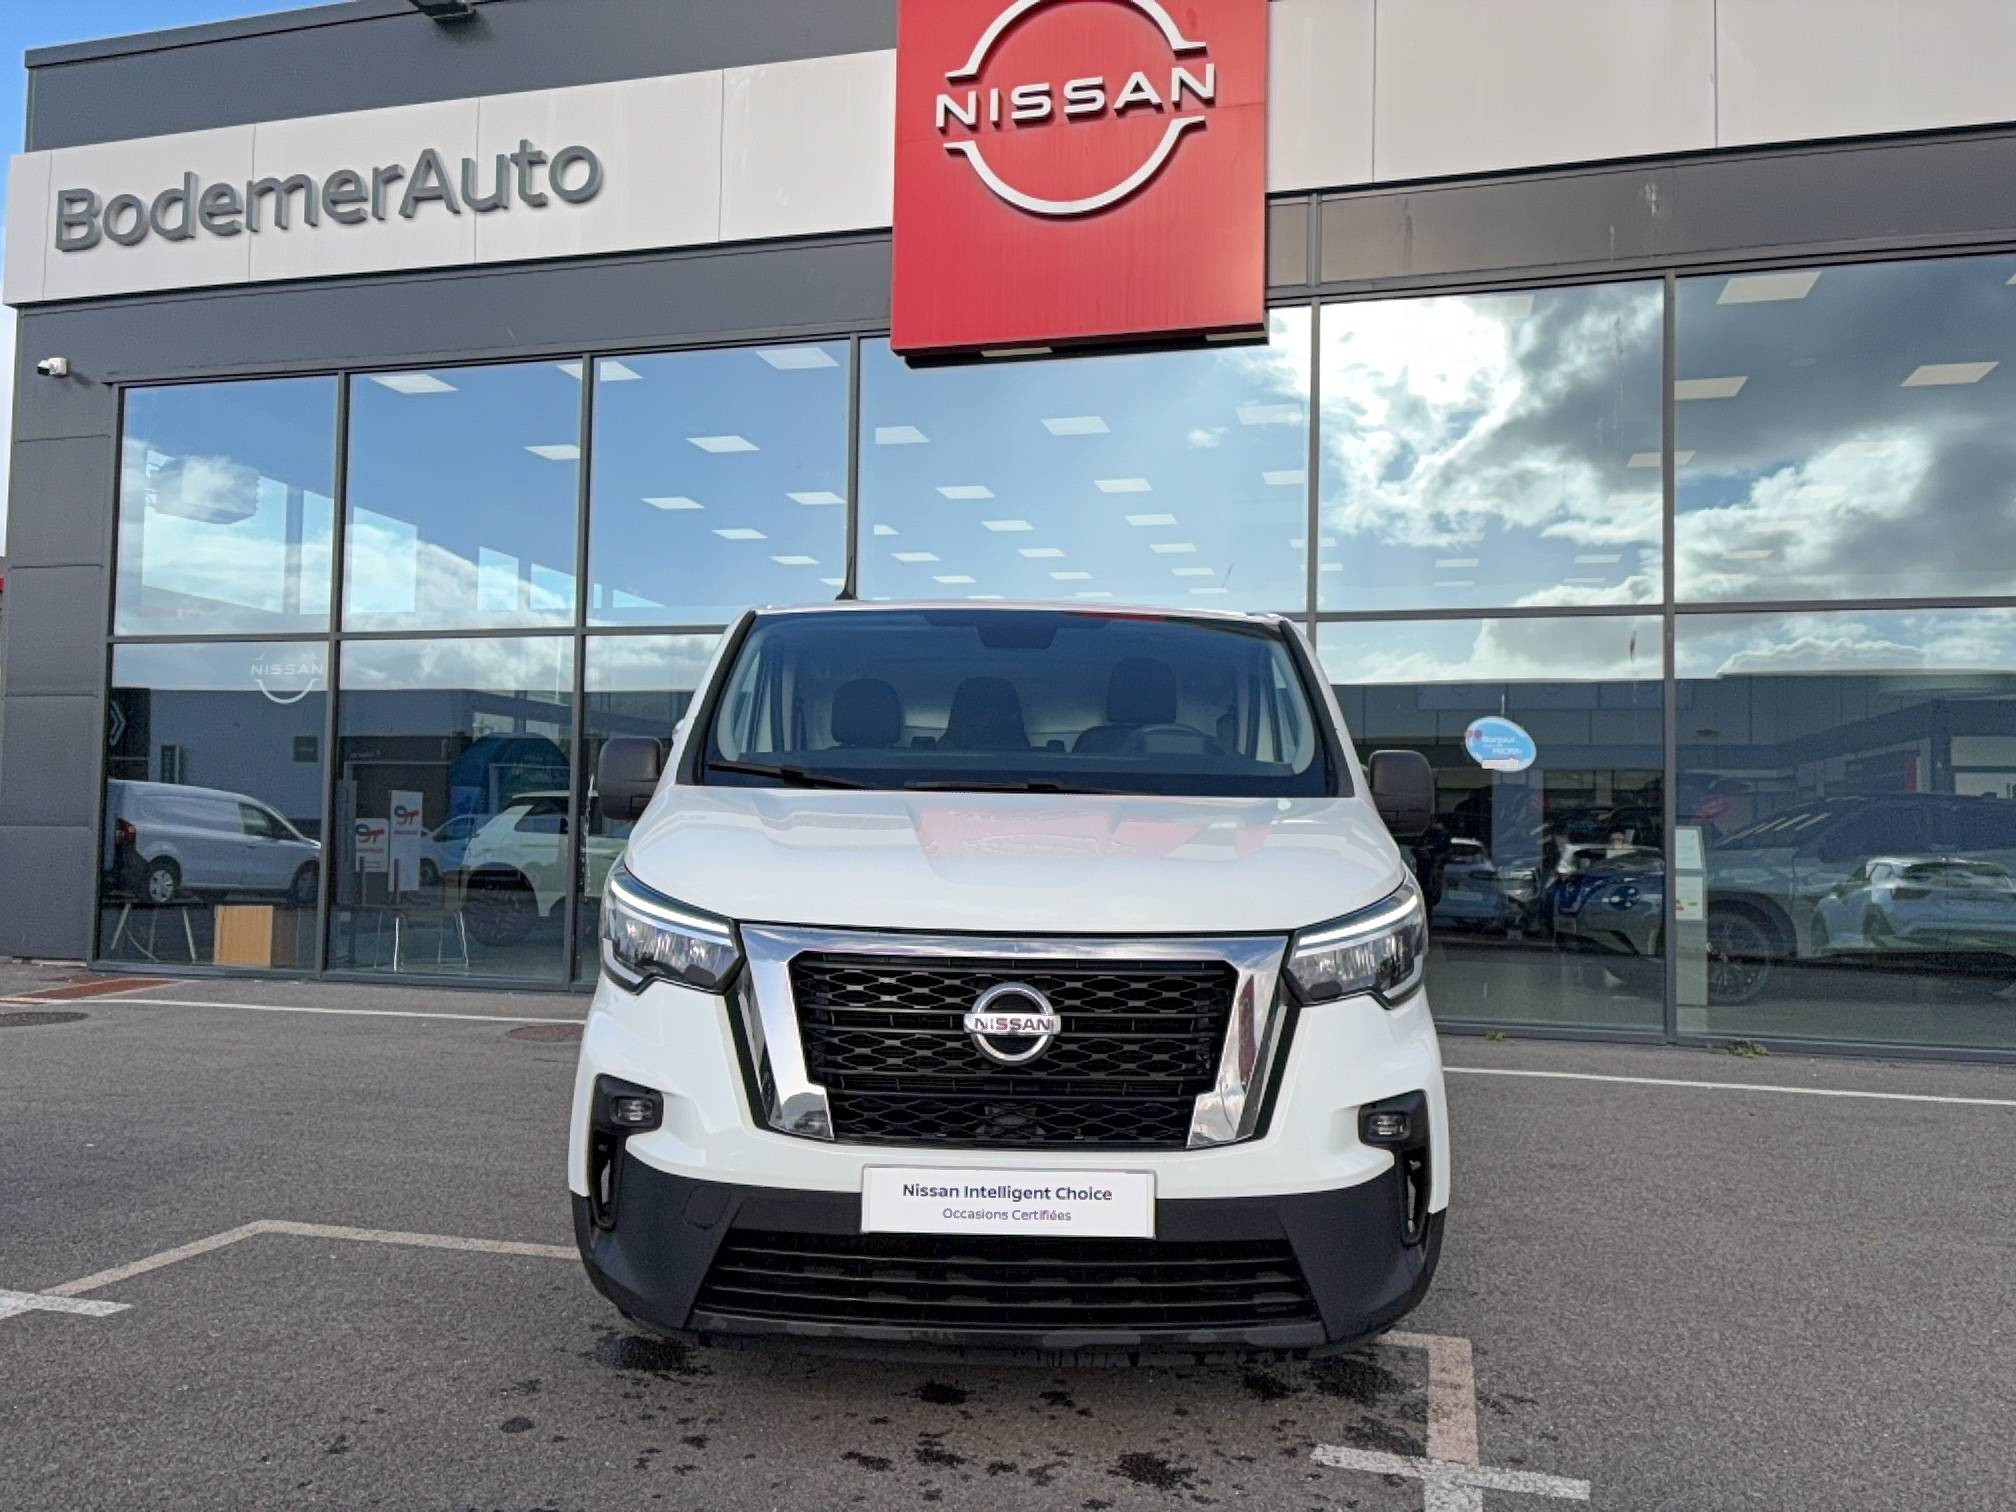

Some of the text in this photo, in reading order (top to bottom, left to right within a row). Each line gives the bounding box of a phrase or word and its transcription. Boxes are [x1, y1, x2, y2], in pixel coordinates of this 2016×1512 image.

[935, 63, 1216, 132] NISSAN
[54, 138, 604, 252] BodemerAuto
[251, 664, 323, 675] NISSAN
[974, 1017, 1050, 1031] NISSAN
[903, 1183, 1113, 1202] Nissan Intelligent Choice
[942, 1207, 1072, 1222] Occasions Certifiées
